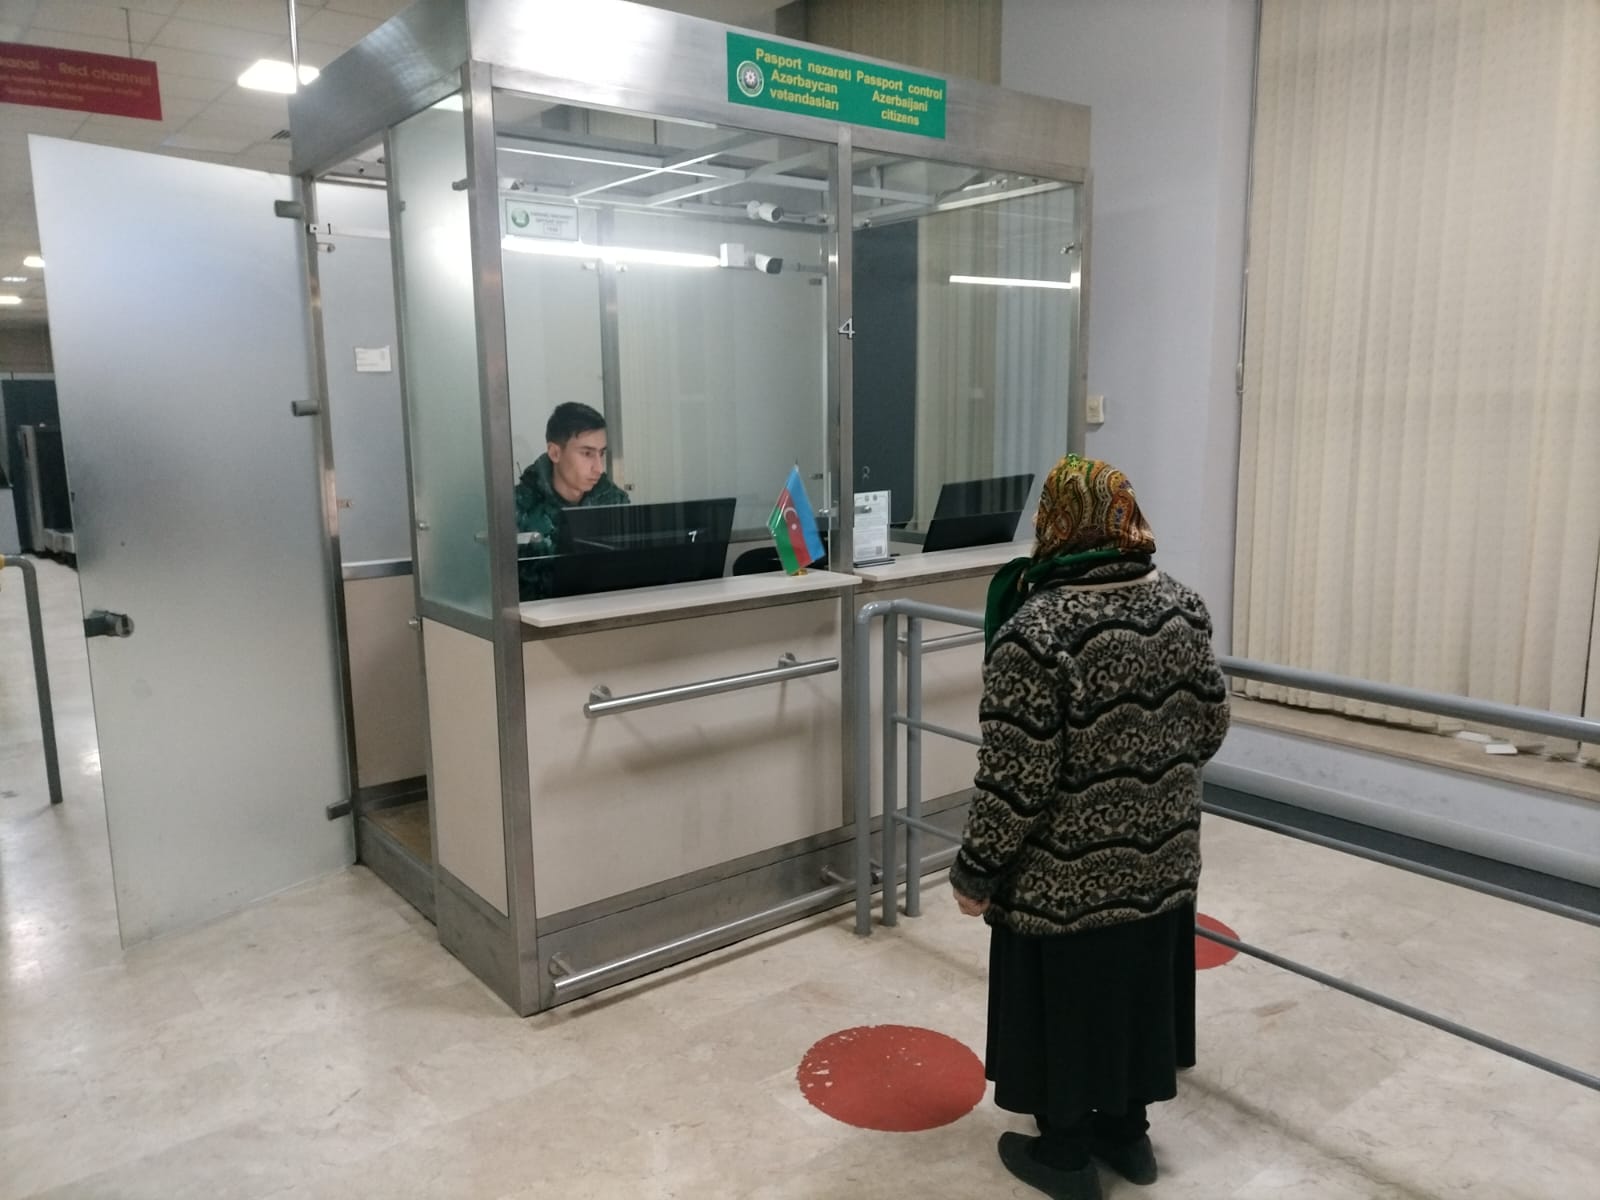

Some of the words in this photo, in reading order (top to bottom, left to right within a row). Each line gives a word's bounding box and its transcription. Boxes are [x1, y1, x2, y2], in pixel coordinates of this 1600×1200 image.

[756, 48, 801, 70] Pasport
[58, 62, 88, 77] Red
[91, 67, 152, 86] channel
[856, 69, 903, 91] Passport
[908, 83, 943, 100] control
[872, 89, 928, 112] Azerbaijani
[881, 108, 919, 126] citizens
[838, 317, 856, 339] 4
